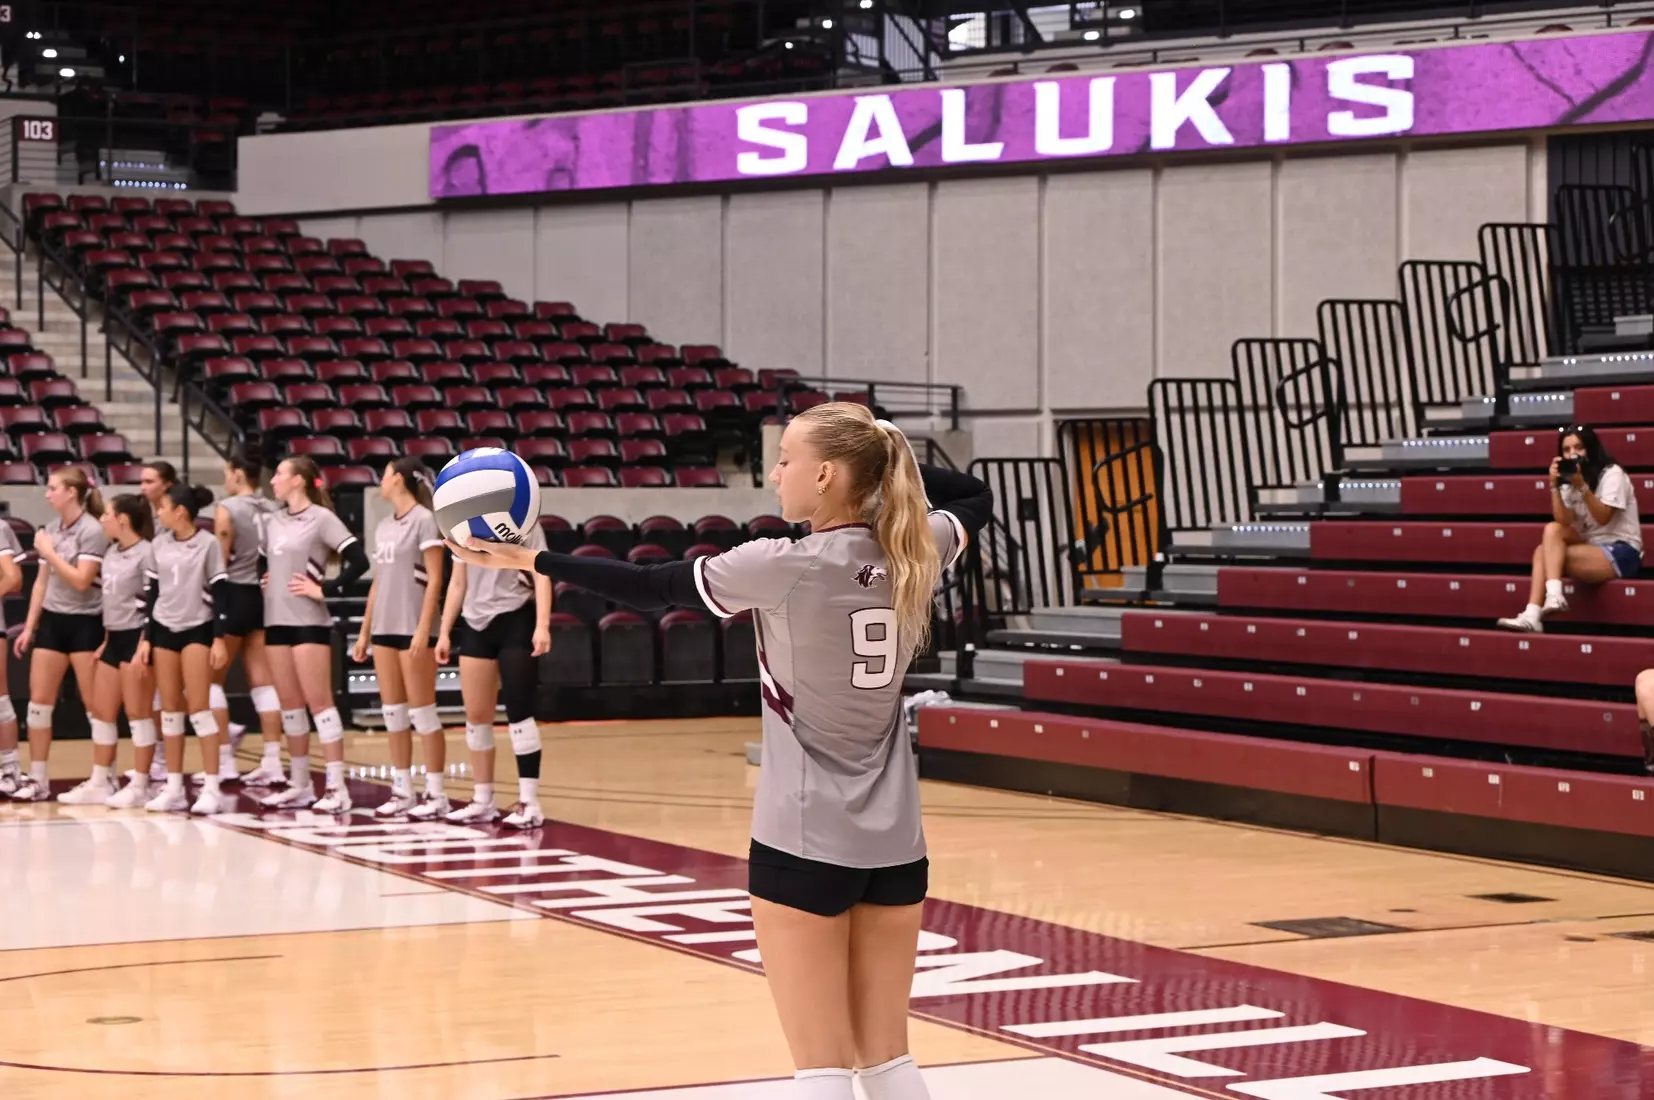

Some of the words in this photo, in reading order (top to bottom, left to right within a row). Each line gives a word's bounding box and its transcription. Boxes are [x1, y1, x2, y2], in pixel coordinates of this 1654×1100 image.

[0, 4, 11, 22] 3
[736, 54, 1415, 175] SALUKIS
[23, 119, 53, 140] 103
[372, 541, 395, 564] 20
[170, 564, 180, 586] 1
[848, 606, 899, 690] 9
